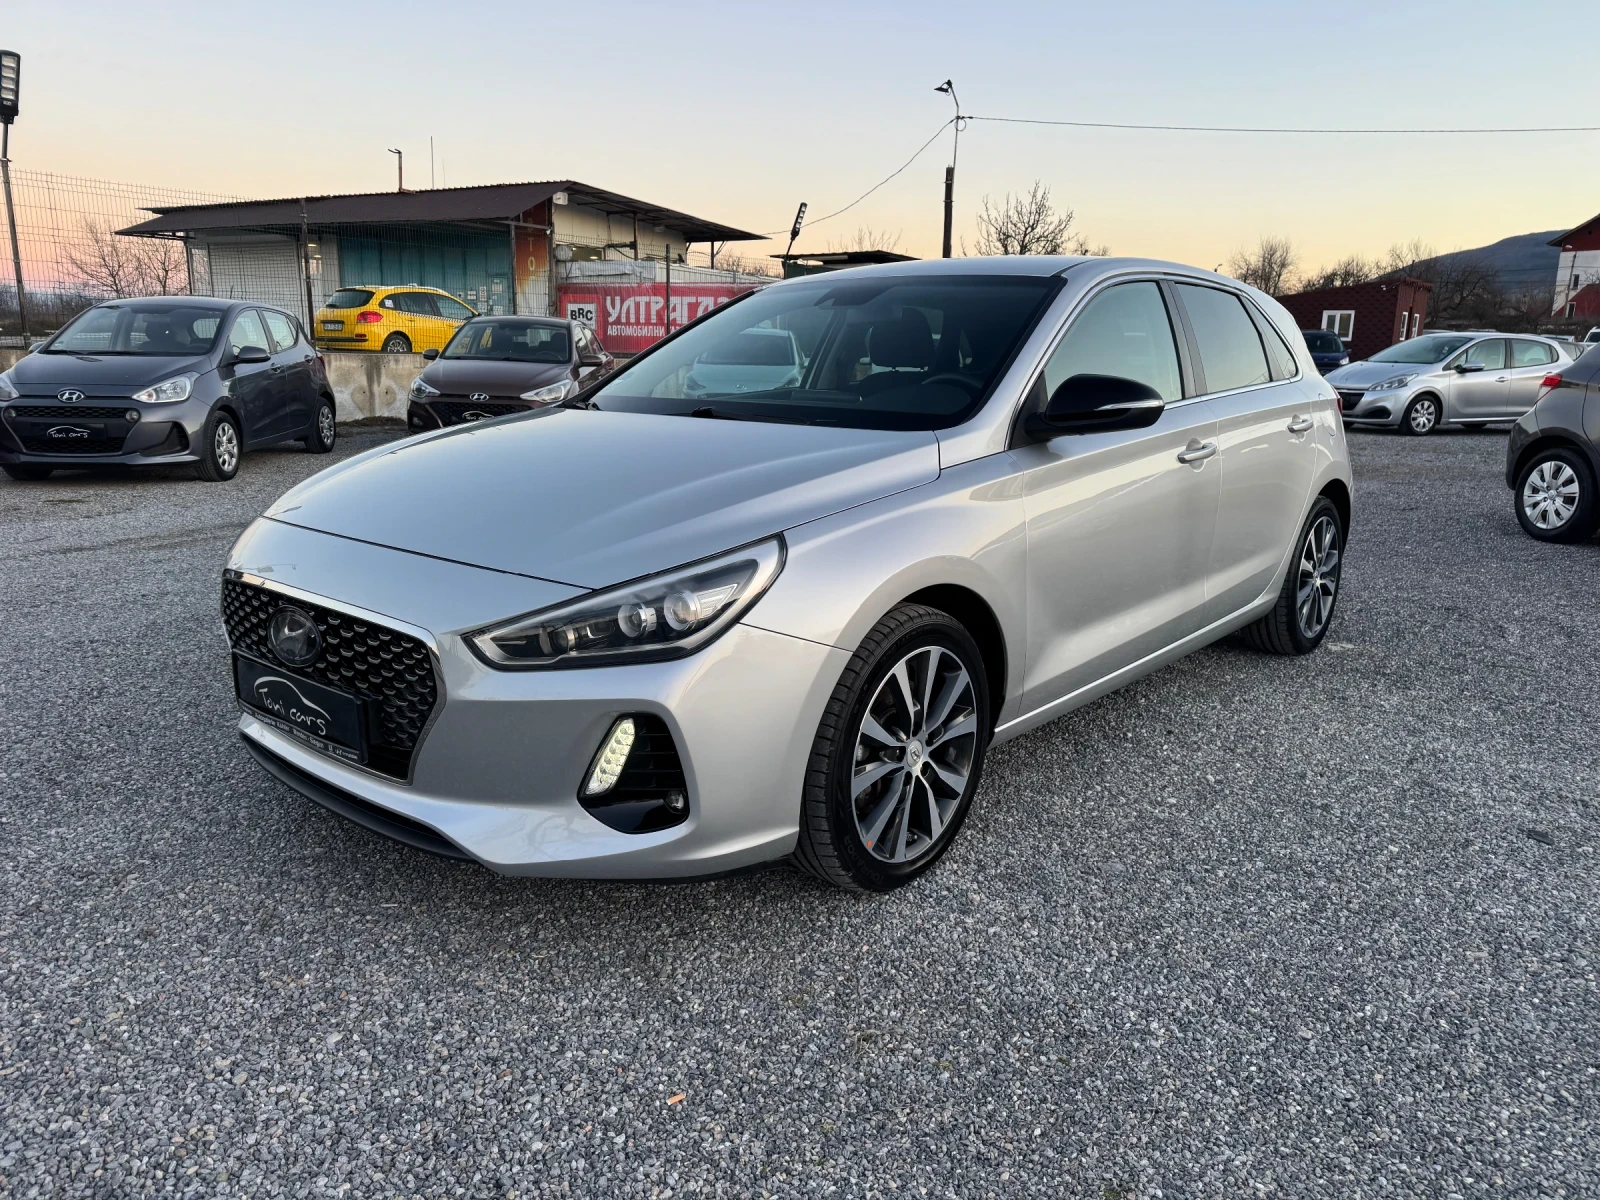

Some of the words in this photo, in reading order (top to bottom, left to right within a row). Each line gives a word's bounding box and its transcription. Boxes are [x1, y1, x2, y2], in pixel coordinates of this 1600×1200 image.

[570, 307, 593, 321] BRC
[605, 295, 730, 324] УЛТРАГА
[607, 324, 665, 337] АВТОМОБИЛНИ
[259, 687, 285, 715] Toni
